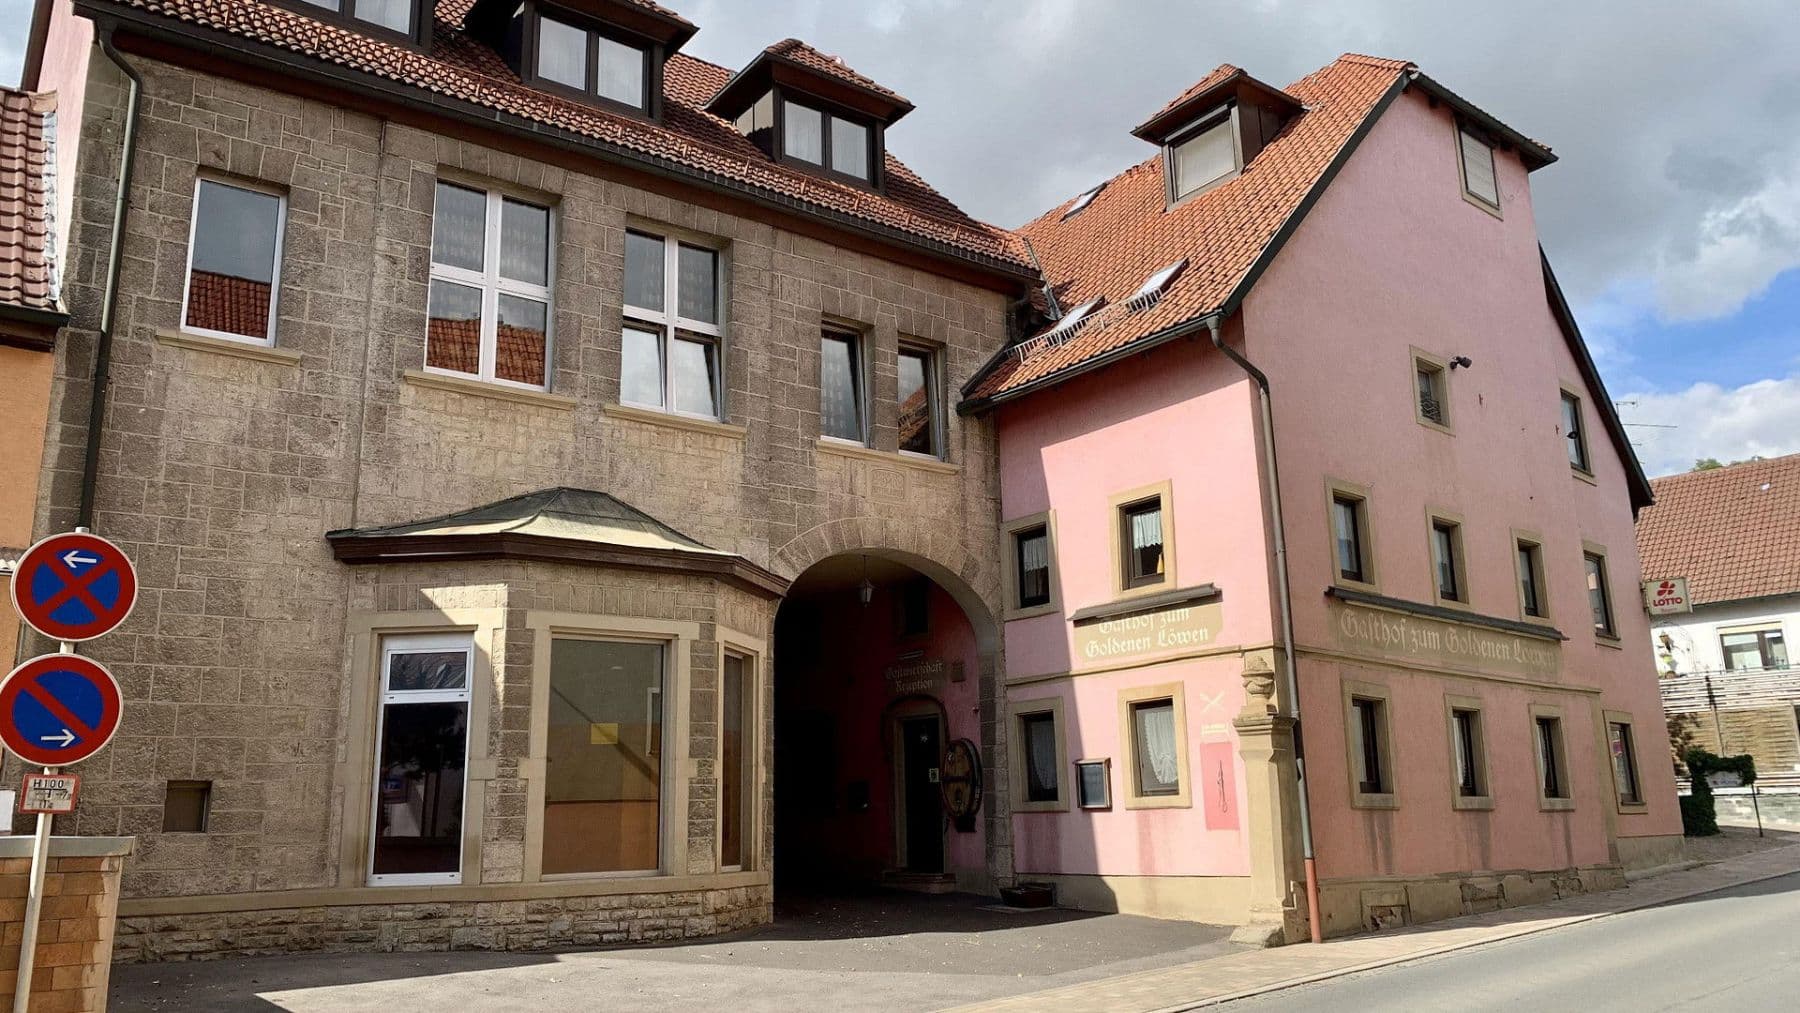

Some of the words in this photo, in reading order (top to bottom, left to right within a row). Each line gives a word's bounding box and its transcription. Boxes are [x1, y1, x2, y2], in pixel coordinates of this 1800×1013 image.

[1653, 597, 1683, 607] LOTTO
[1085, 636, 1150, 658] Goldenen
[1158, 628, 1209, 647] Löwen
[1341, 608, 1407, 648] Gasthof
[1411, 628, 1441, 652] zum
[1445, 627, 1511, 660] Goldenen
